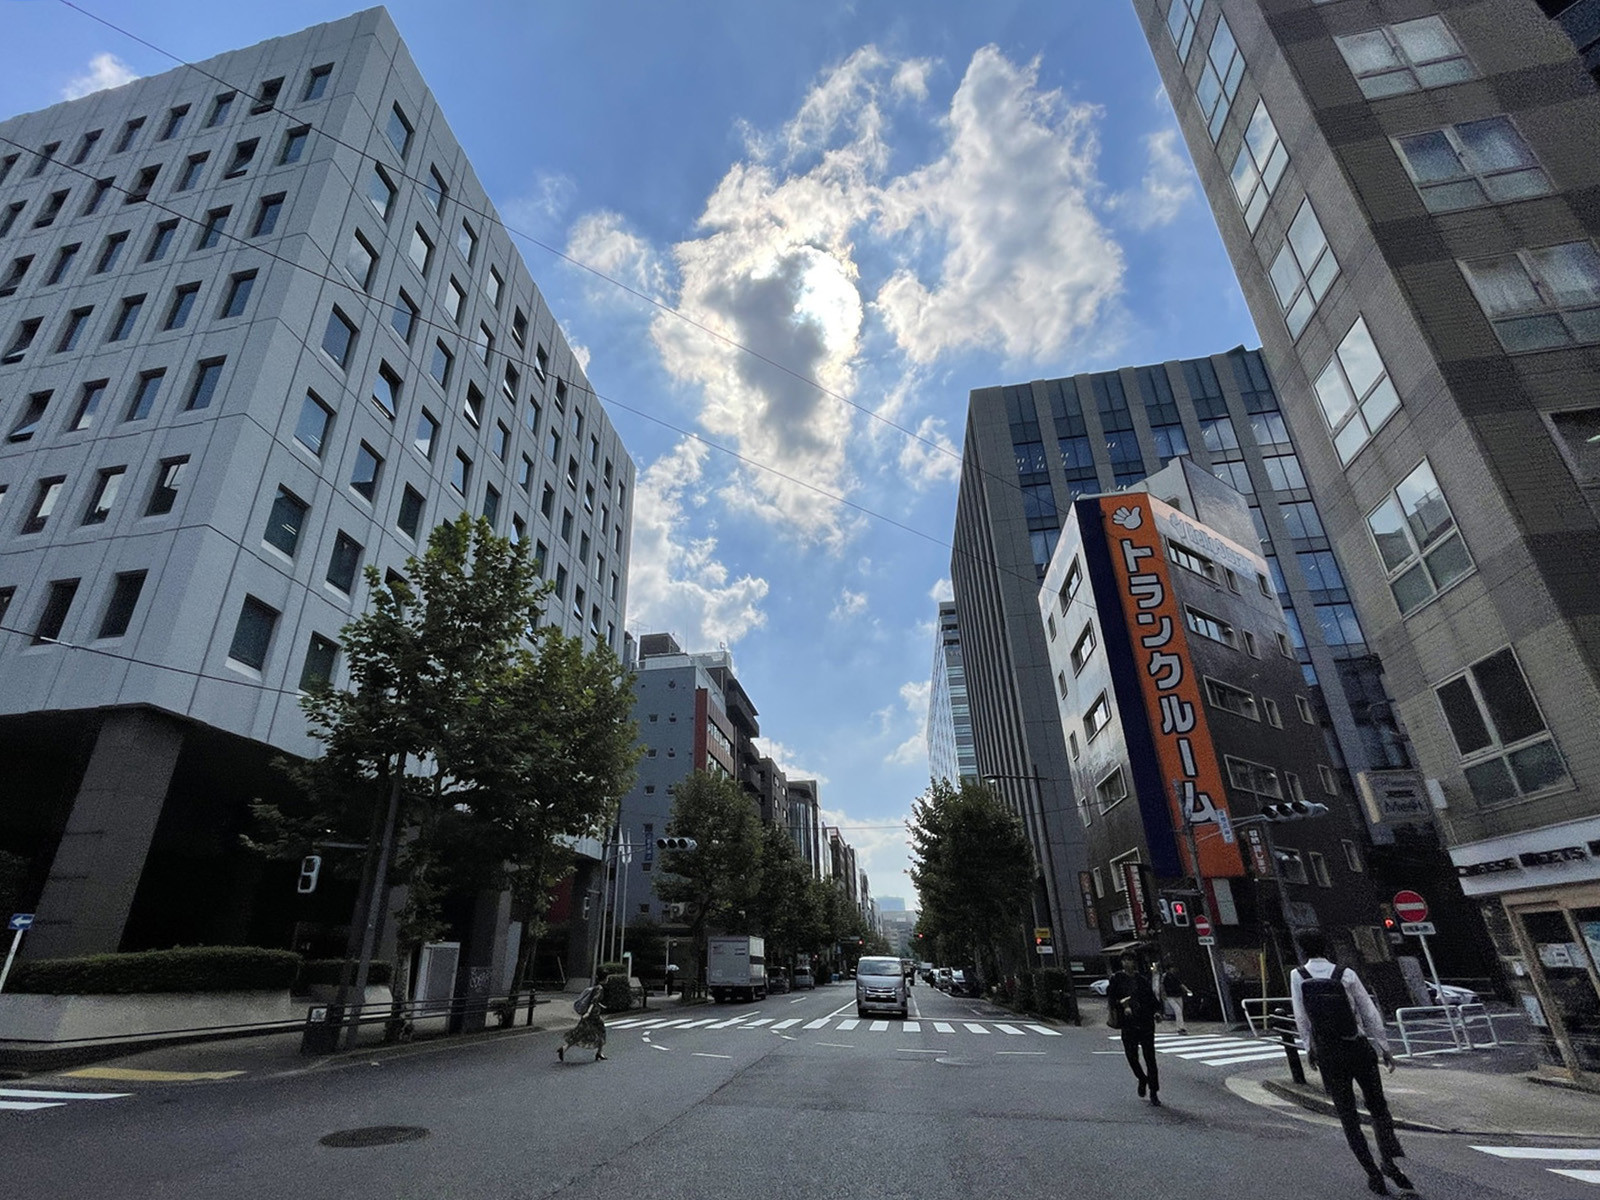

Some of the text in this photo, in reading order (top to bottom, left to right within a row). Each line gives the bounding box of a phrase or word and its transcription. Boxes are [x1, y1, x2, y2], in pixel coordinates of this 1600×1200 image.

[1121, 539, 1219, 823] トランクルーム
